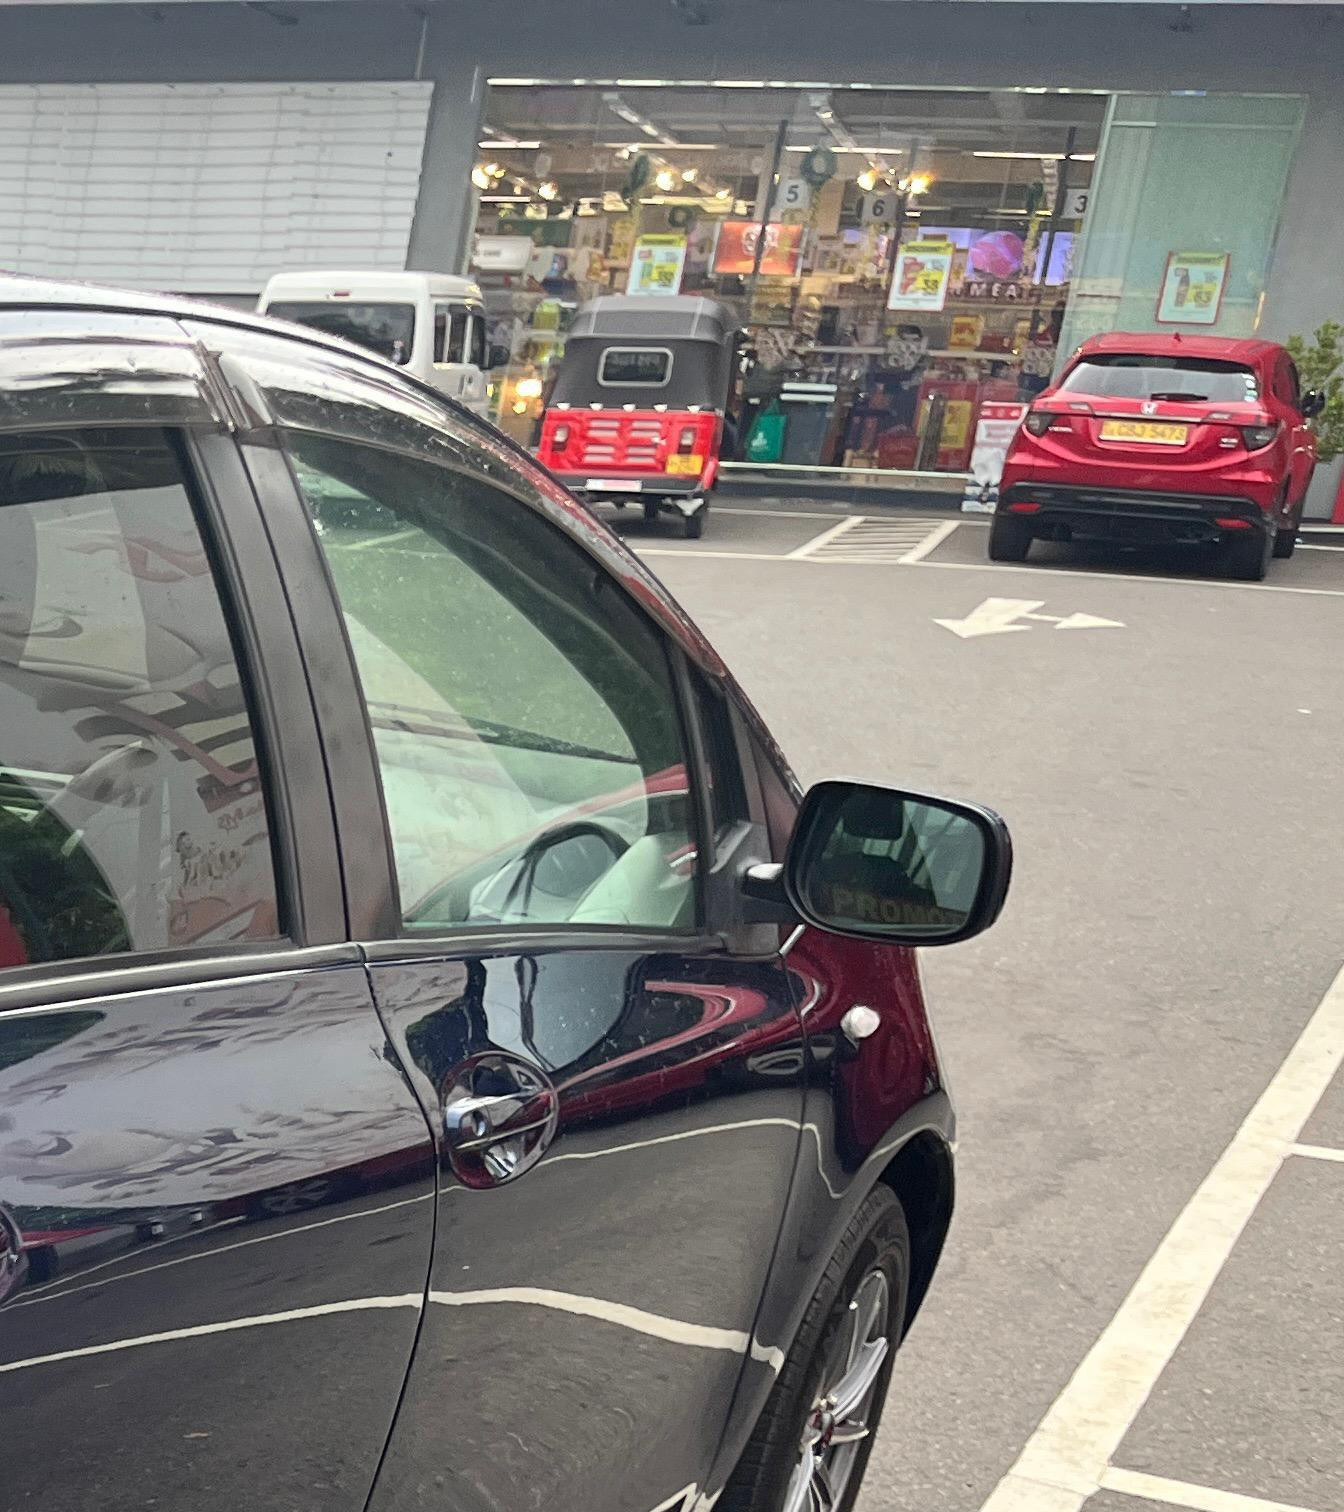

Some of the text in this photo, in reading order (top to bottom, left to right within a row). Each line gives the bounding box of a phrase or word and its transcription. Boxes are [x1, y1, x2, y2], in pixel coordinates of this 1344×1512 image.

[785, 184, 800, 203] 5
[871, 199, 886, 218] 6
[1073, 194, 1088, 215] 3
